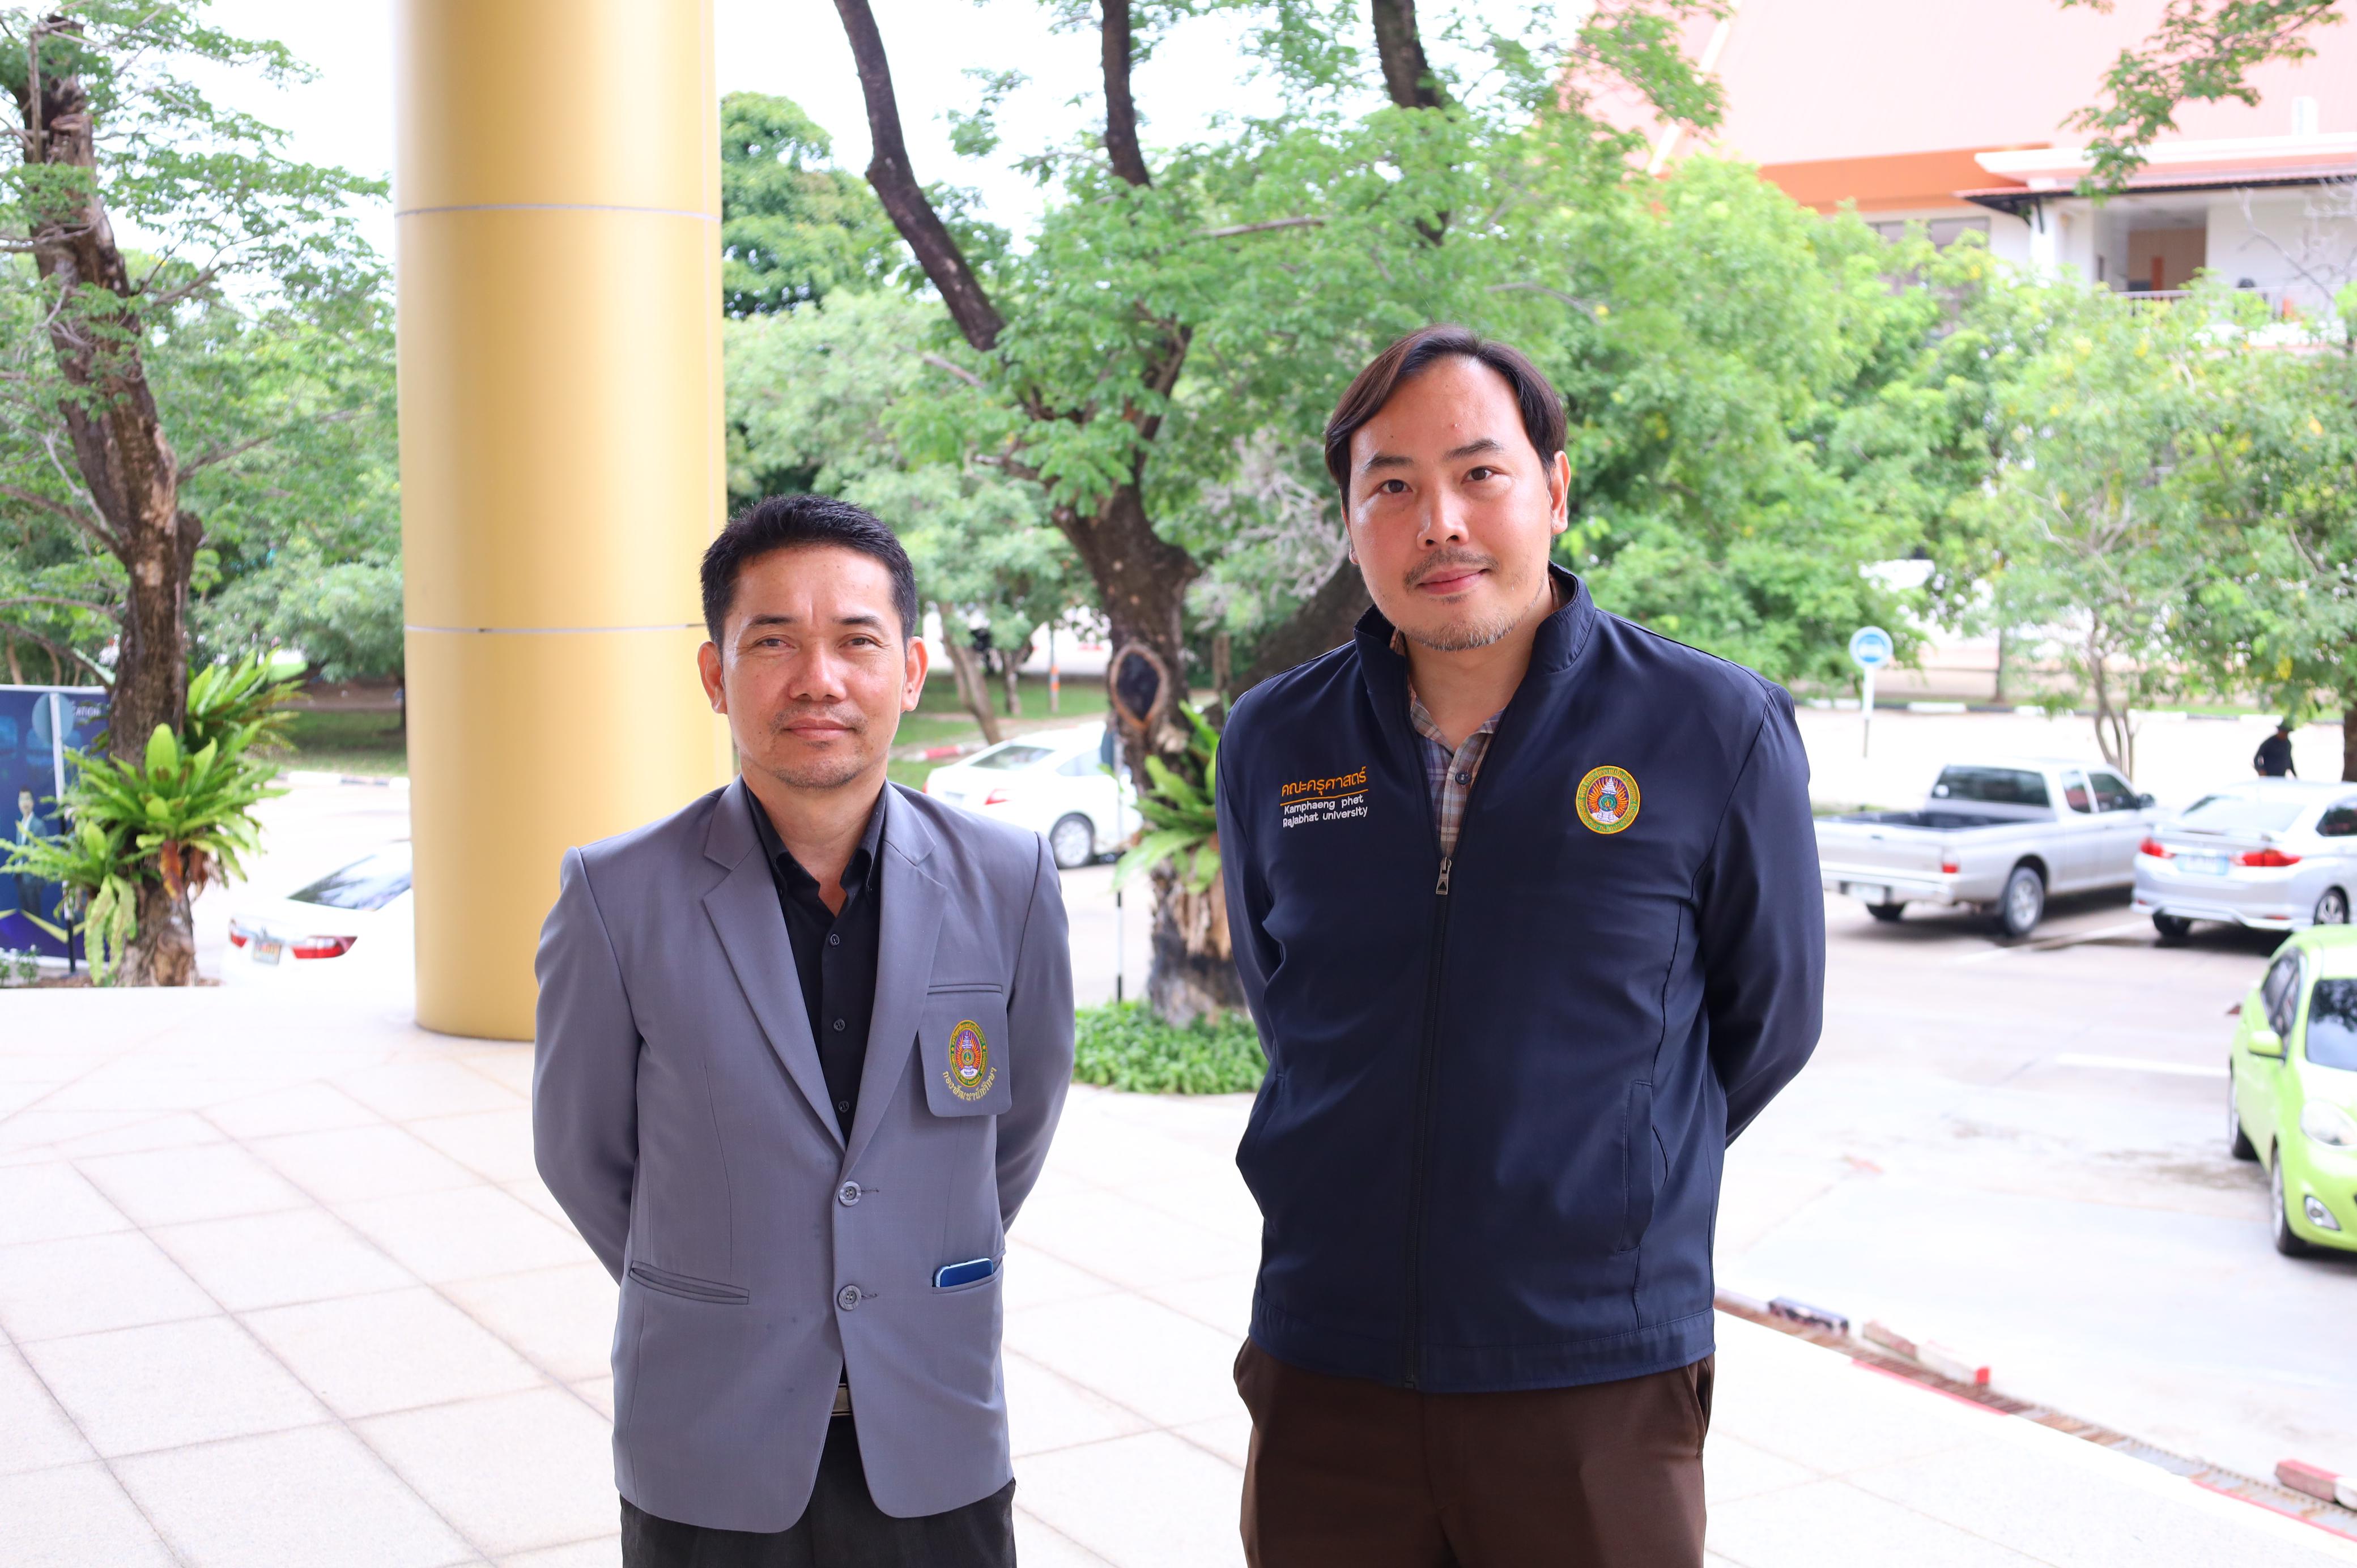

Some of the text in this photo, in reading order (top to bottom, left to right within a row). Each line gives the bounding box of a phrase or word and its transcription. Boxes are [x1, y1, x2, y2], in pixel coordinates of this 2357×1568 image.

[1281, 766, 1367, 796] คณะครุศาสตร์
[1283, 806, 1368, 828] Rajabhat university
[1284, 794, 1364, 815] Kamphaeng phet
[942, 1067, 997, 1101] กองพัฒนานักศึกษา
